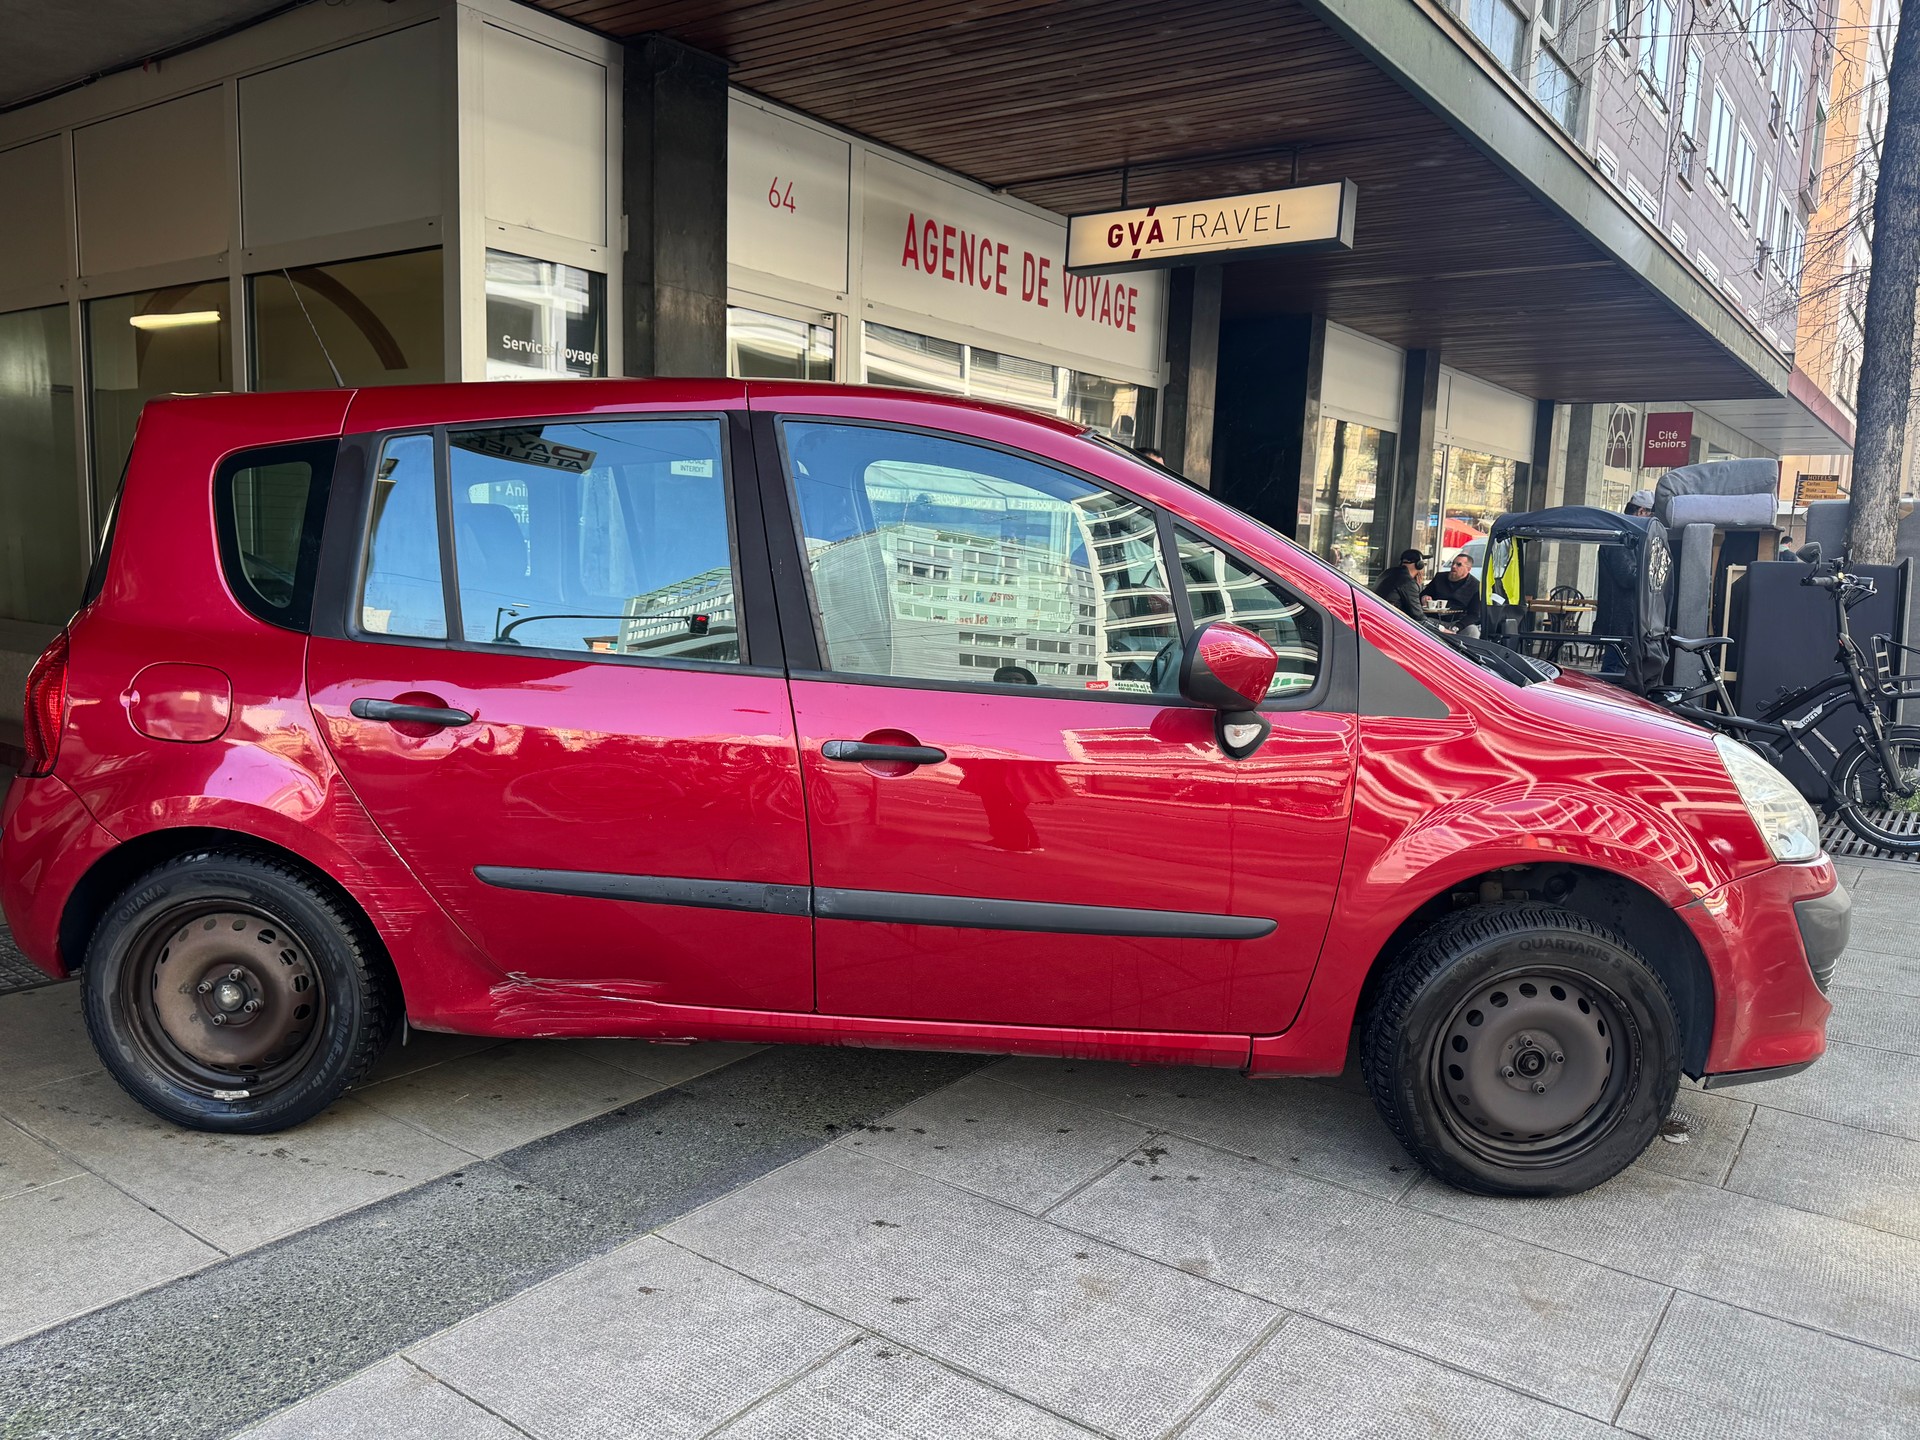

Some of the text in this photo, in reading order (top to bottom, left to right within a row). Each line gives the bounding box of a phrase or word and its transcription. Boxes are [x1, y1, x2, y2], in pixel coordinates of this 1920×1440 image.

[768, 176, 796, 213] 64
[1107, 204, 1291, 248] GVA TRAVEL
[902, 213, 1138, 332] AGENCE DE VOYAGE
[1648, 440, 1687, 449] Seniors
[1658, 431, 1678, 440] Cité
[106, 884, 167, 935] KOHAMA
[1518, 938, 1611, 962] QUARTARIS
